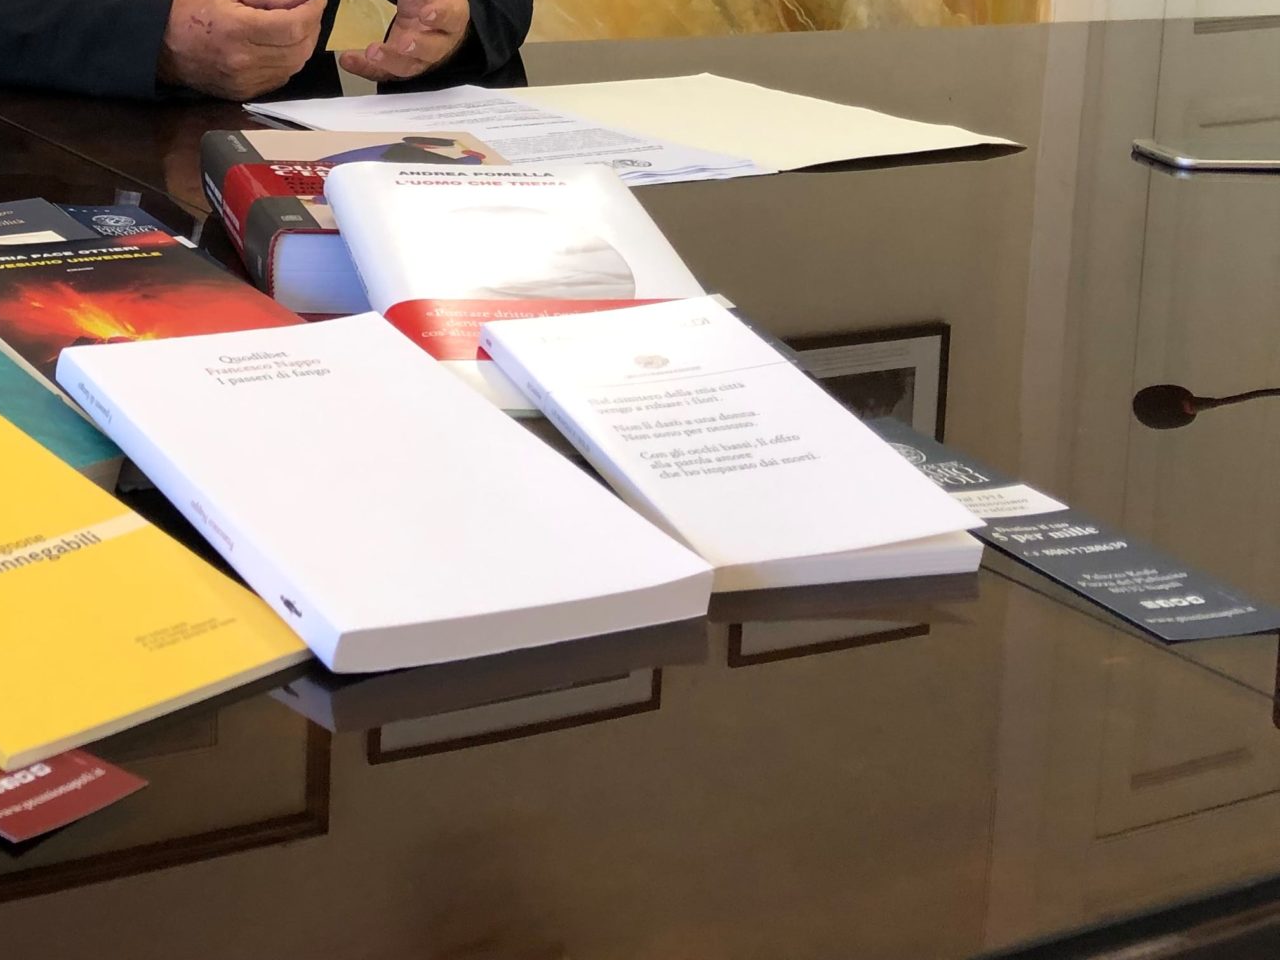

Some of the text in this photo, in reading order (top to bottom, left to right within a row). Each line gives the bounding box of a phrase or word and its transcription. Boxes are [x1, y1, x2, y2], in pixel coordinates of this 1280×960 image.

[31, 251, 73, 259] PACE
[78, 246, 140, 255] OTTIERI
[67, 252, 162, 263] UNIVERSALE
[218, 351, 288, 364] Quodlibet
[205, 358, 322, 376] Francesco Nappo
[276, 371, 291, 379] di
[683, 428, 703, 437] per
[992, 527, 1099, 543] 5 per mille
